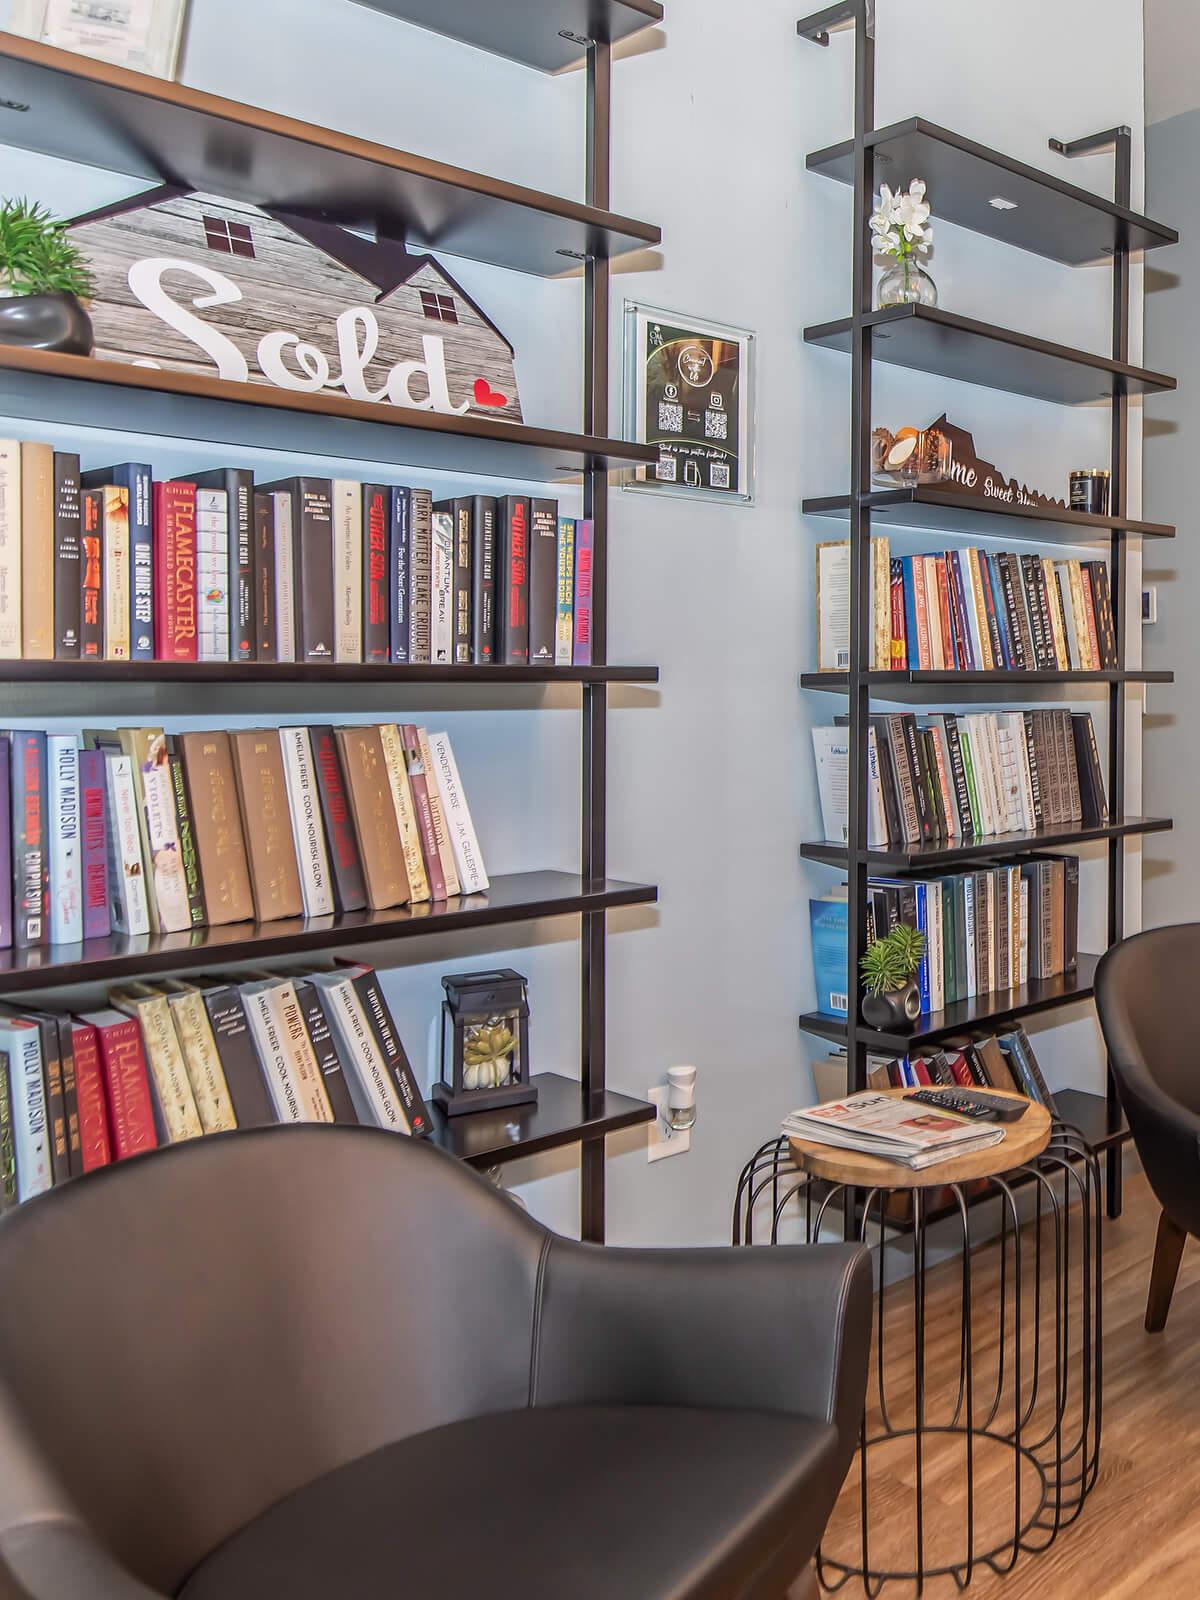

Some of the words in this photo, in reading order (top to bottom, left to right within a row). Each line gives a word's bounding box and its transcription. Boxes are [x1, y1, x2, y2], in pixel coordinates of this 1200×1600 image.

[128, 258, 469, 415] Sold
[983, 476, 1014, 503] Sweet
[416, 497, 428, 522] DARK
[239, 533, 248, 545] THE
[370, 506, 384, 550] OTHER
[416, 527, 428, 564] MATTER
[511, 516, 524, 557] OTHER
[135, 544, 151, 565] ONE
[174, 500, 195, 642] FLAMECASTER
[370, 552, 384, 580] SON
[512, 560, 524, 584] SON
[135, 567, 151, 595] MORE
[416, 575, 428, 605] BLAKE
[136, 597, 151, 623] STEP
[577, 608, 589, 644] DEATHDATE
[416, 611, 428, 650] CROUCH
[294, 731, 306, 763] AMELIA
[894, 721, 903, 739] DARK
[59, 748, 75, 782] HOLLY
[897, 742, 908, 770] MATTER
[298, 763, 309, 790] FREER
[435, 740, 456, 792] VENDETTA'S
[450, 792, 461, 809] RISE
[903, 776, 912, 798] BLAKE
[60, 787, 76, 840] MADISON
[149, 776, 163, 840] VIOLETS
[428, 794, 445, 847] harmony
[907, 802, 919, 831] CROUCH
[455, 822, 467, 840] J.M.
[461, 839, 479, 881] GILLESPIE
[25, 851, 42, 915] COMPULSION
[88, 864, 105, 908] DEATHDATE
[257, 995, 271, 1026] AMELIA
[267, 1027, 279, 1052] FREER
[283, 1003, 304, 1042] POWERS
[339, 985, 353, 1014] AMELIA
[351, 1013, 364, 1038] FREER
[23, 1040, 41, 1075] HOLLY
[26, 1079, 47, 1136] MADISON
